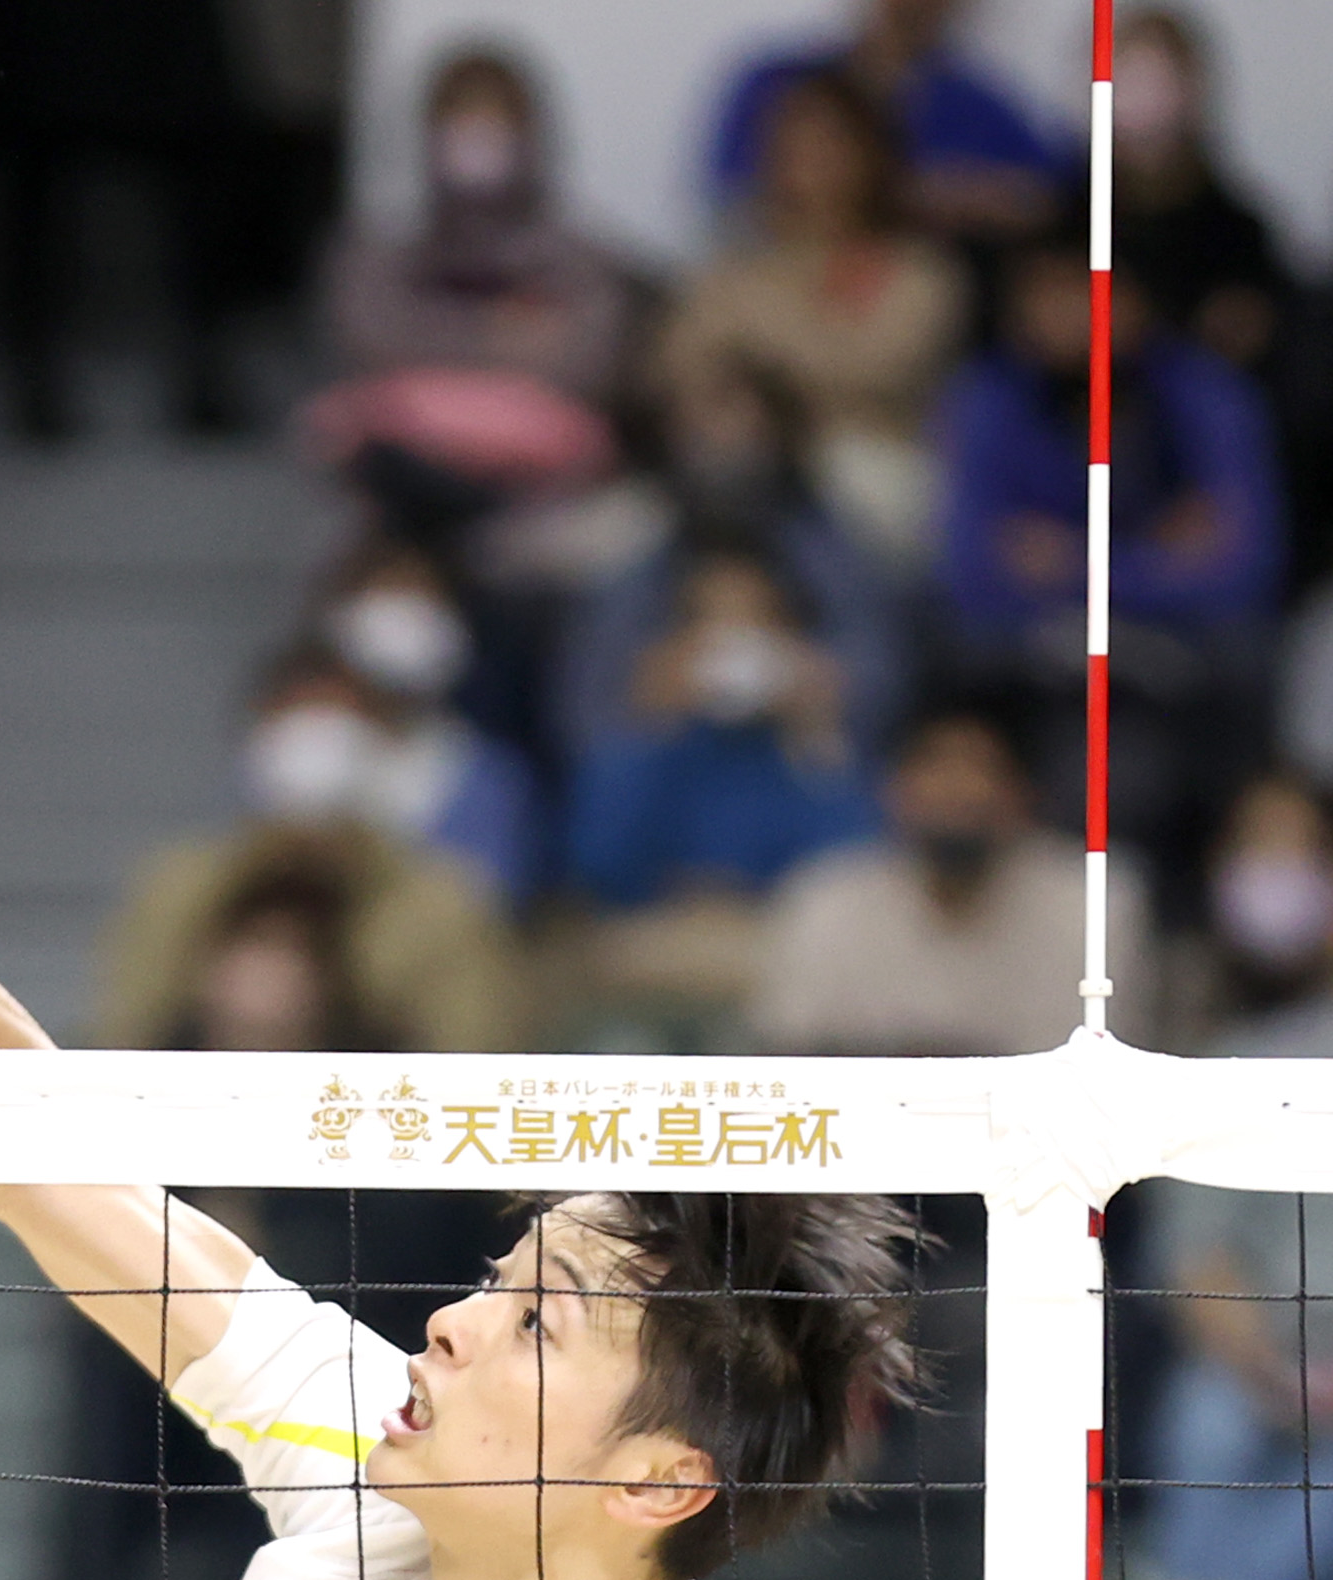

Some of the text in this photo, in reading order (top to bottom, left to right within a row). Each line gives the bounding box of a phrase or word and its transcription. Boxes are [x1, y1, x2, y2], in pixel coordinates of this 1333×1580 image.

[498, 1079, 787, 1099] 全日本バレーボール選手権大会
